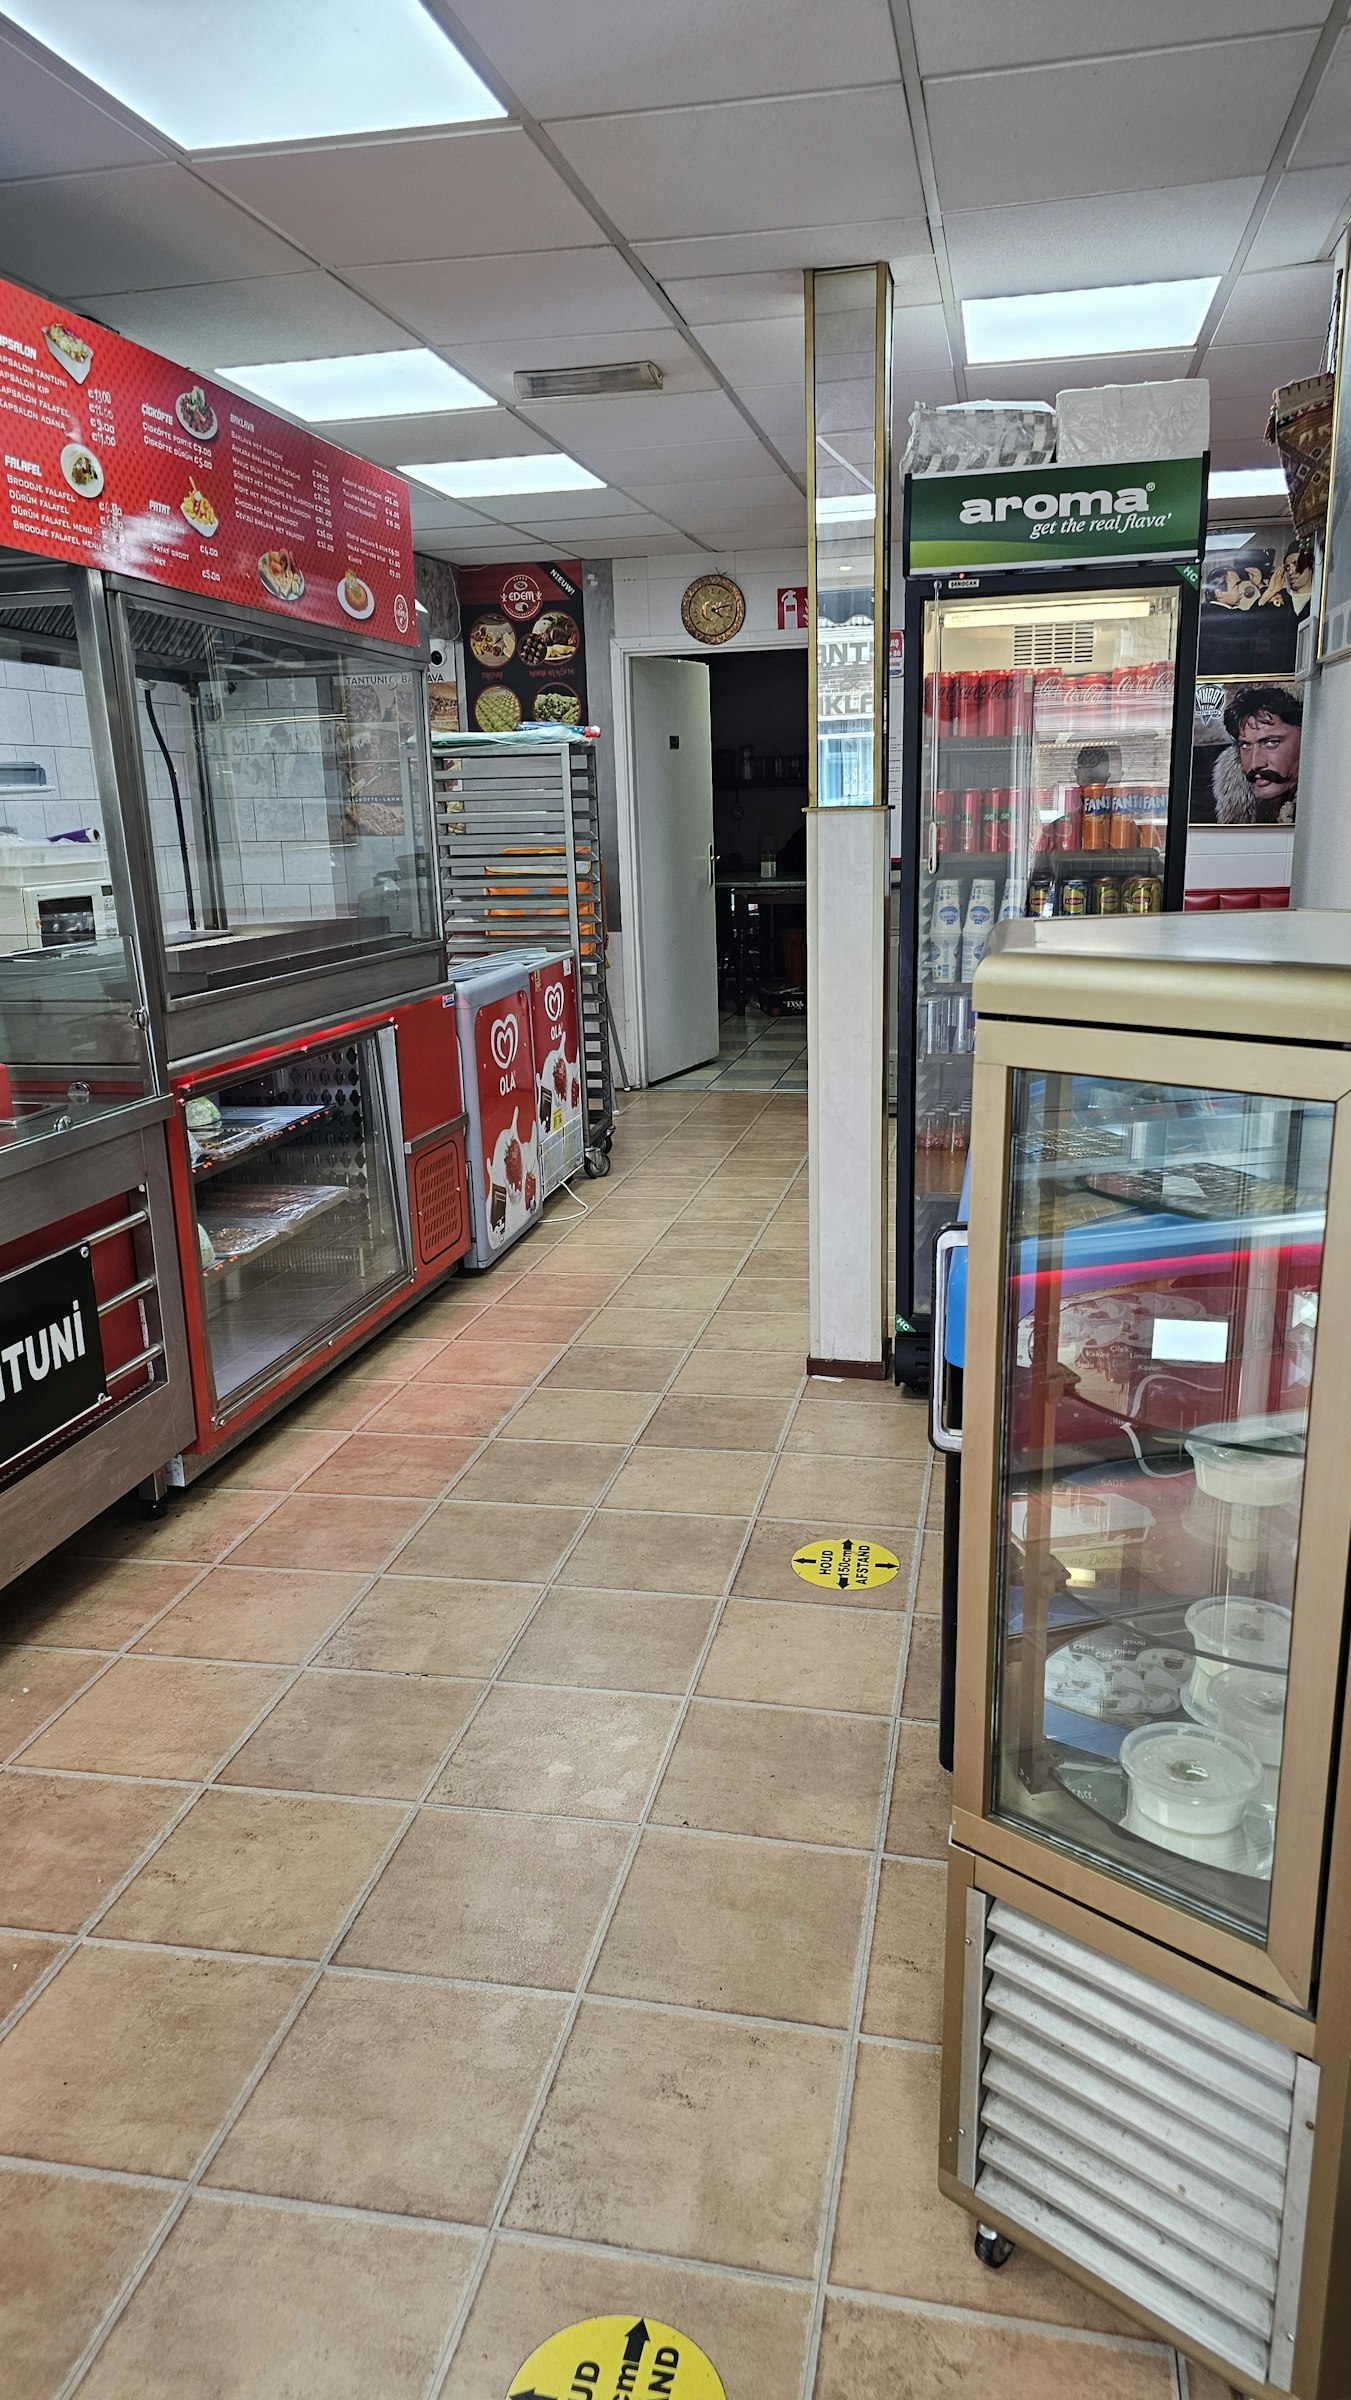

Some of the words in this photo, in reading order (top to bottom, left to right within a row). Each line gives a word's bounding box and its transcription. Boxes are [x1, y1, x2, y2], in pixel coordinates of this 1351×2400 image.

[0, 335, 37, 360] PSALON
[0, 370, 35, 391] APSALON
[38, 385, 50, 396] KIP
[36, 369, 68, 389] TANTUNI
[0, 386, 37, 405] APSALON
[39, 399, 70, 418] FALAFEL
[41, 414, 66, 430] ADANA
[230, 413, 255, 433] BAKLAVA
[4, 454, 42, 478] FALAFEL
[7, 474, 44, 493] BROODJE
[45, 487, 76, 502] FALAFEL
[40, 499, 70, 515] FALAFEL
[149, 499, 171, 515] PATAT
[959, 487, 1149, 525] aroma
[13, 520, 50, 538] BROODJE
[51, 532, 81, 547] FALAFEL
[41, 514, 71, 530] FALAFEL
[73, 523, 93, 535] MENU
[1029, 520, 1058, 540] get
[1060, 518, 1084, 535] the
[1089, 515, 1119, 533] real
[171, 549, 190, 560] GROOT
[550, 569, 576, 596] NIEUW!
[1183, 565, 1199, 583] HC
[508, 591, 536, 603] EDEM
[346, 676, 388, 687] TANTUNI
[551, 1023, 564, 1041] OLA
[500, 1071, 517, 1097] OLA
[896, 1317, 910, 1331] HC
[1085, 1350, 1110, 1359] Kakao
[1138, 1363, 1162, 1372] Kavun
[1100, 1479, 1125, 1489] SADE
[818, 1550, 834, 1576] HOUD
[837, 1549, 852, 1578] 150cm
[855, 1545, 870, 1585] AFSTAND
[648, 2346, 680, 2400] ND
